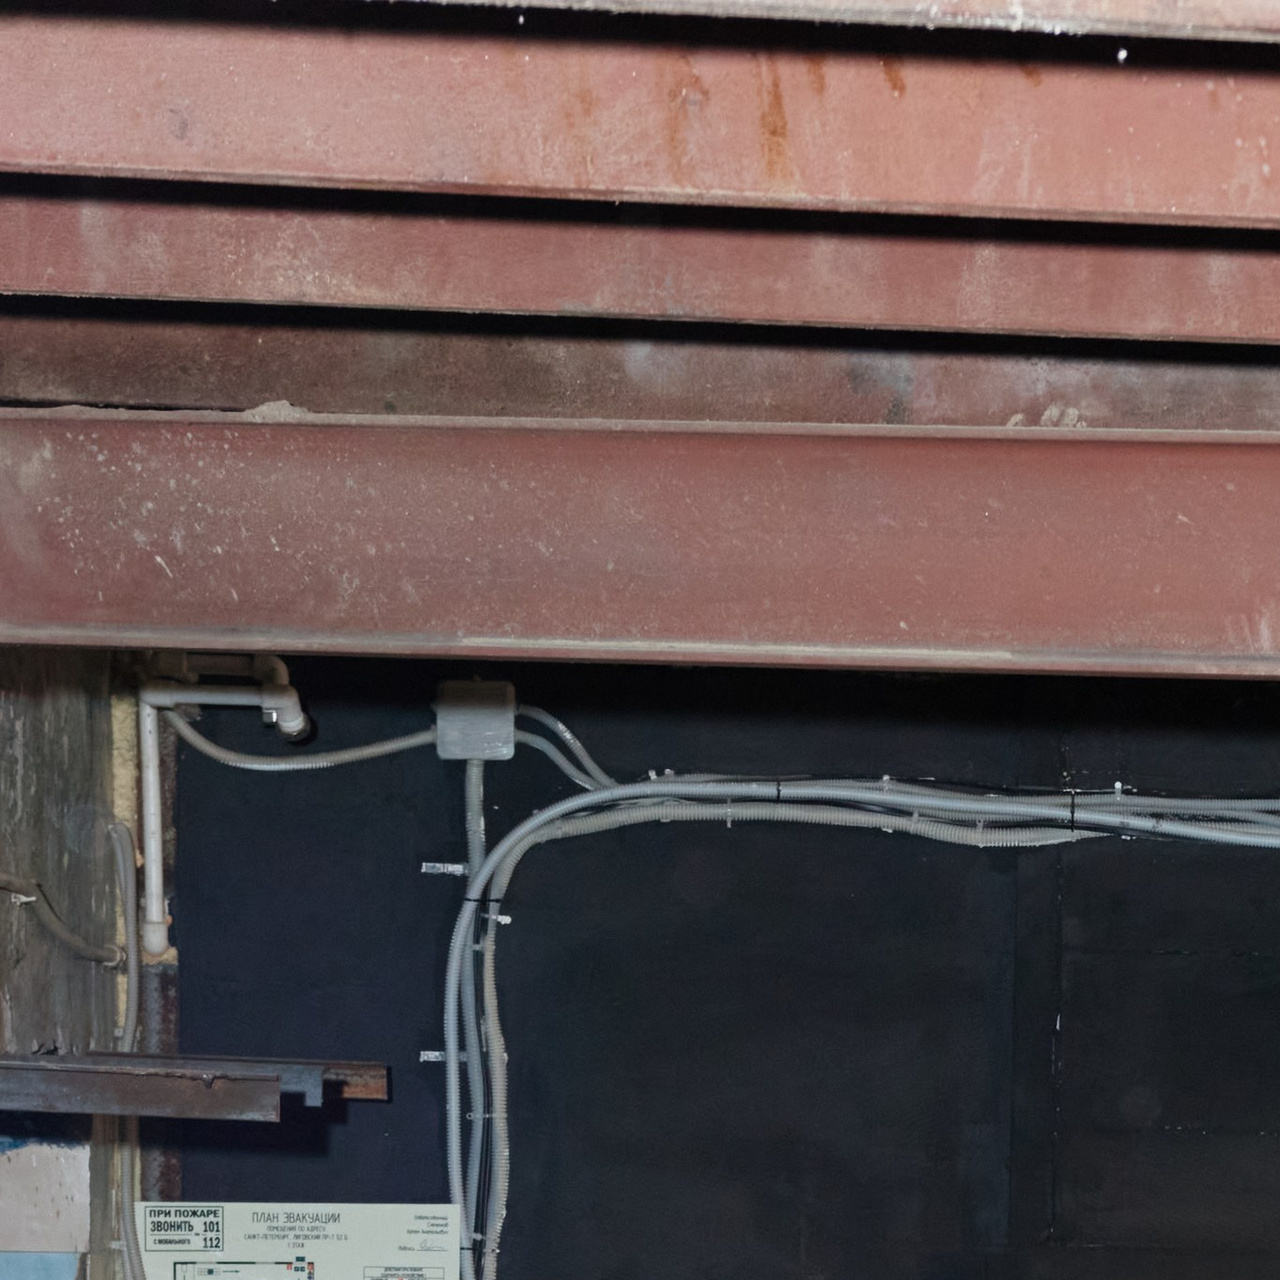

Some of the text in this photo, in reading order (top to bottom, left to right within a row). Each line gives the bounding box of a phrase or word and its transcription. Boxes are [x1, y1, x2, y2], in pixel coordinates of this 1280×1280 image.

[149, 1209, 220, 1218] ПРИ ПОЖАРЕ
[252, 1212, 341, 1224] ПЛАН ЭВАКУАЦИИ
[150, 1221, 194, 1232] ЗВОНИТЬ
[203, 1221, 220, 1233] 101
[203, 1237, 220, 1248] 112
